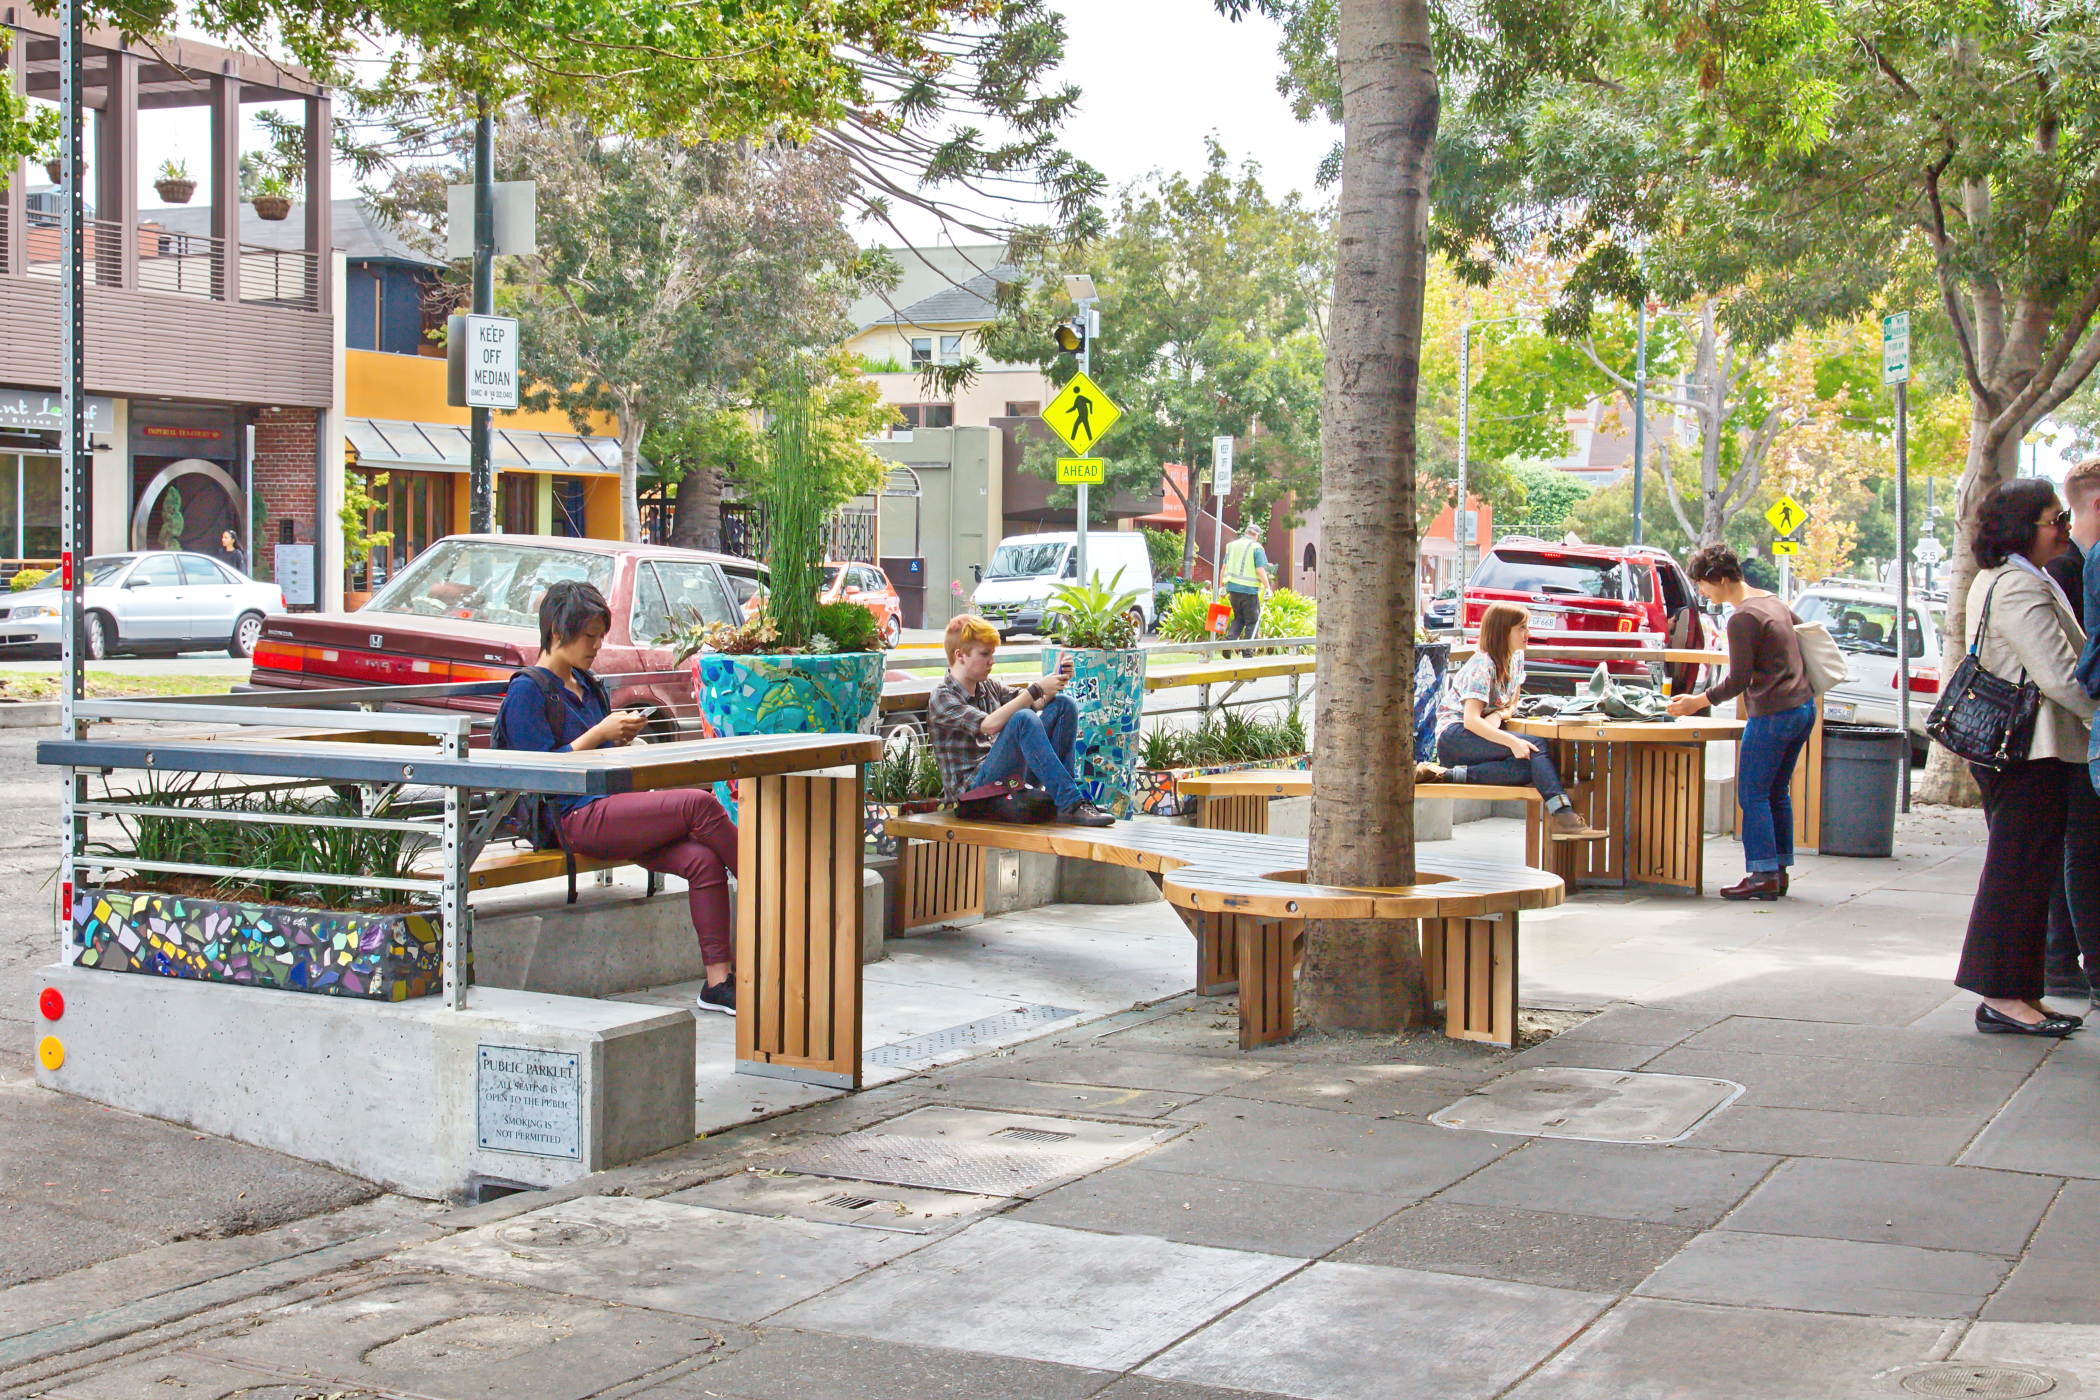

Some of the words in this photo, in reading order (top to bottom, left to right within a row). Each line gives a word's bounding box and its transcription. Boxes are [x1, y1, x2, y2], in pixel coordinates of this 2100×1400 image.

[479, 326, 505, 343] KEEP
[1884, 323, 1892, 336] 30
[483, 348, 502, 364] OFF
[474, 369, 510, 386] MEDIAN
[471, 388, 482, 396] BMC
[148, 428, 176, 436] IMPERIAL
[1062, 466, 1098, 476] AHEAD
[1920, 552, 1936, 560] 25
[1528, 616, 1554, 626] FGF668
[268, 629, 294, 637] HONDA
[483, 1060, 522, 1074] PUBLIC
[526, 1064, 573, 1078] PARKLET
[500, 1081, 512, 1090] ALL
[514, 1082, 548, 1093] SEATING
[550, 1085, 558, 1094] IS
[486, 1092, 508, 1102] OPEN
[510, 1095, 522, 1104] TO
[523, 1096, 539, 1106] THE
[541, 1098, 570, 1109] PUBLIC
[504, 1116, 542, 1128] SMOKING
[544, 1120, 552, 1129] IS
[496, 1130, 513, 1138] NOT
[516, 1131, 560, 1144] PERMITTED
